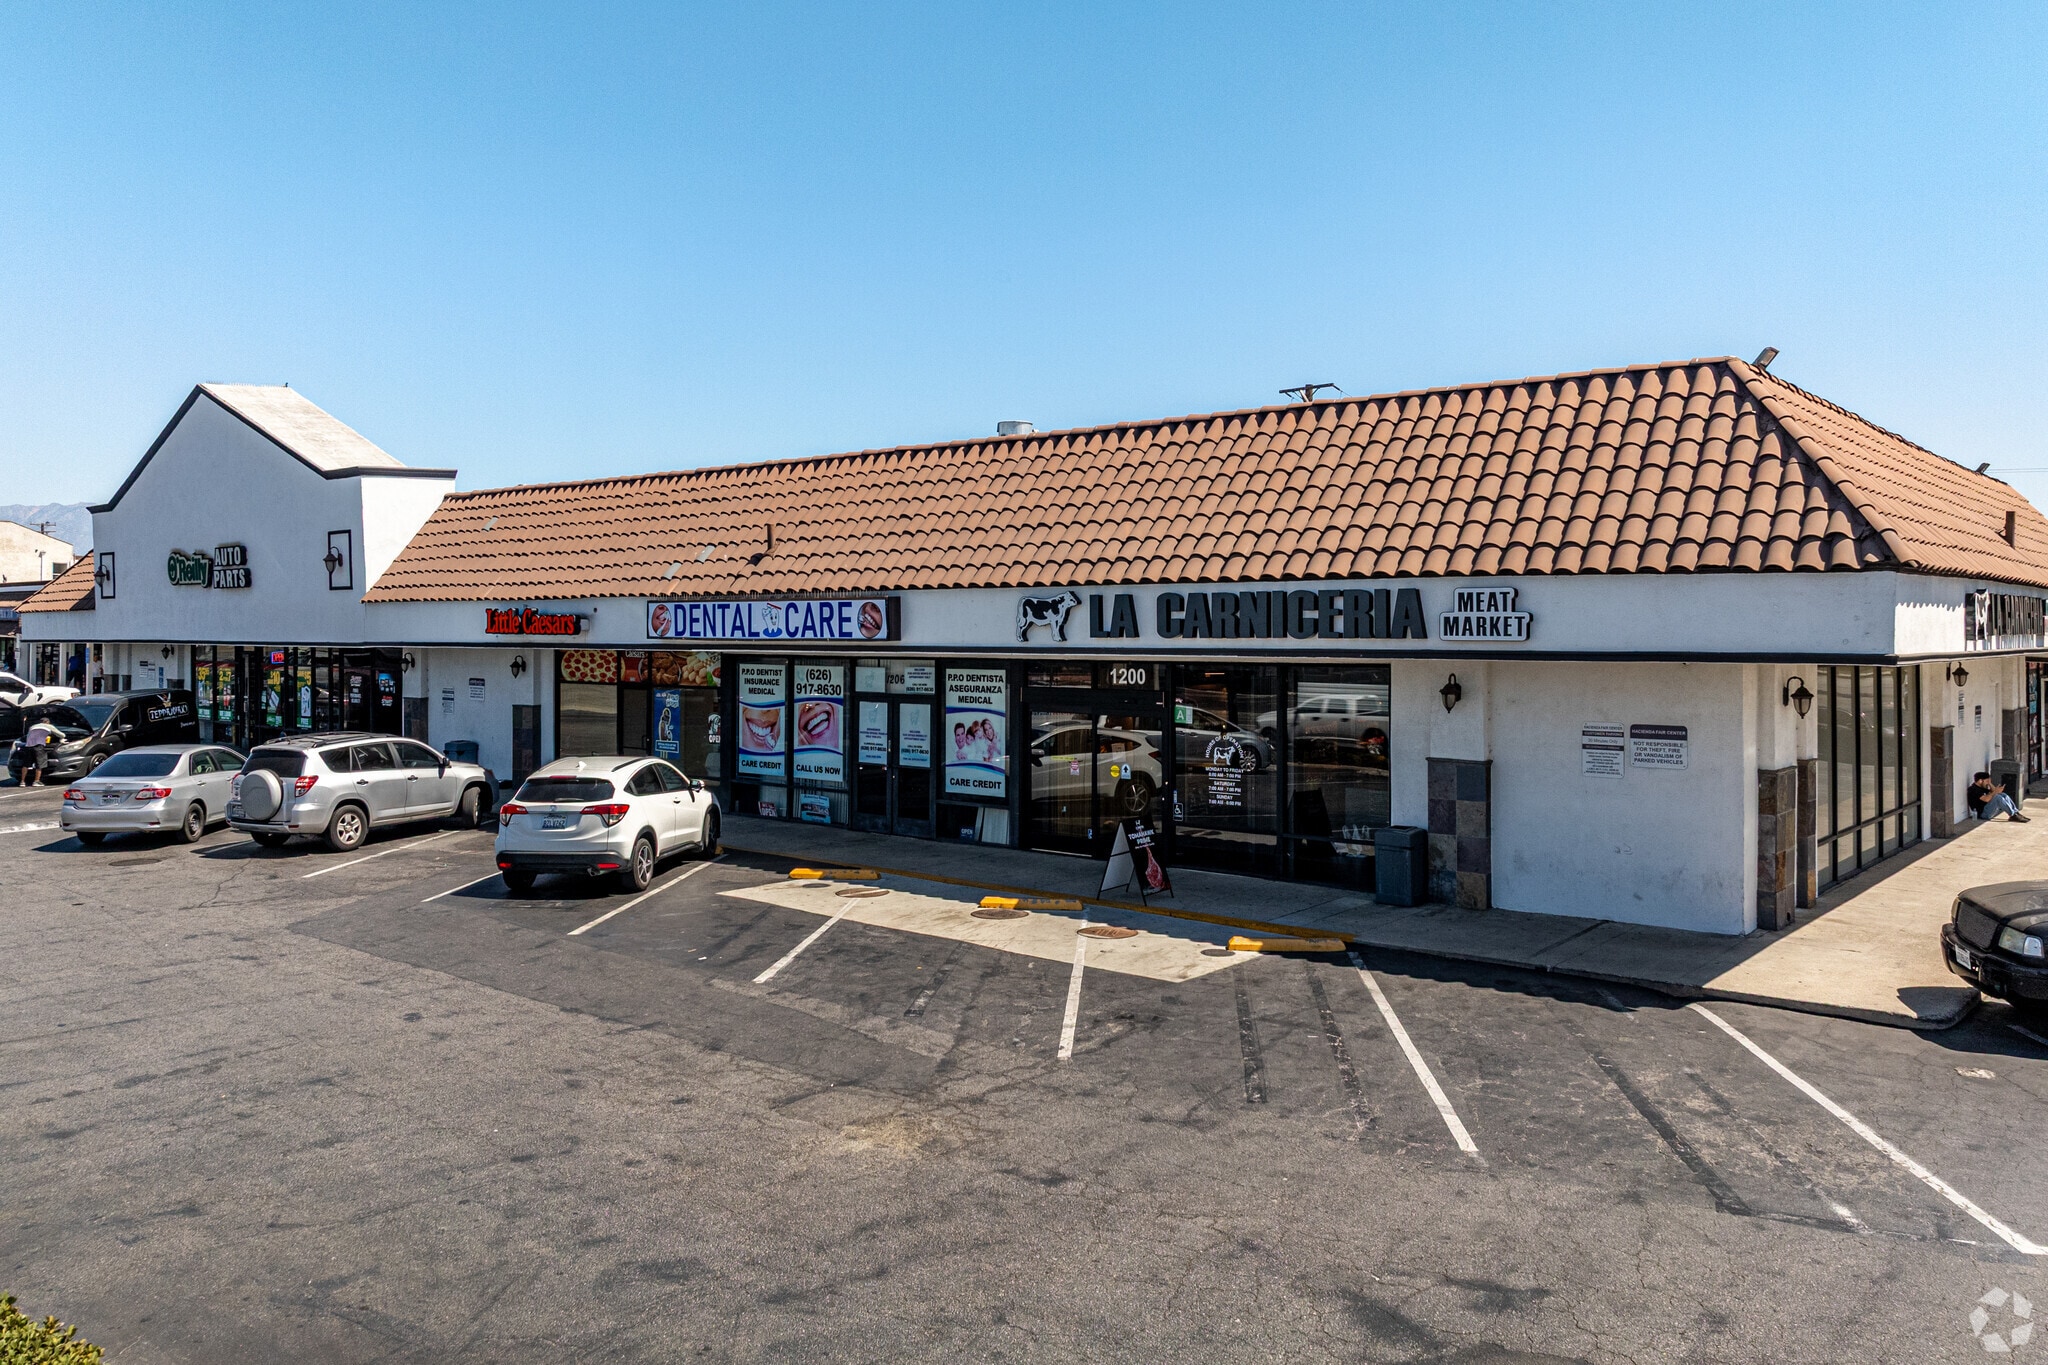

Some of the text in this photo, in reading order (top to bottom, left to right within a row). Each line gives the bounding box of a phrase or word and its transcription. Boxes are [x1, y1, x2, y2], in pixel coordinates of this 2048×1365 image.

[215, 547, 241, 566] AUTO
[168, 553, 210, 588] O'Reilly
[213, 569, 246, 588] PARTS
[1457, 592, 1511, 612] MEAT
[674, 601, 853, 638] DENTAL CARE
[1089, 587, 1428, 639] LA CARNICERIA
[485, 608, 575, 635] Little Caesars
[1443, 615, 1526, 637] MARKET
[756, 669, 783, 677] DENTIST
[806, 669, 832, 683] (626)
[948, 674, 1004, 683] P.P.O DENTISTA
[1110, 668, 1146, 685] 1200
[744, 678, 780, 686] INSURANCE
[748, 687, 776, 696] MEDICAL
[796, 683, 842, 696] 917-8630
[949, 685, 1003, 694] ASEGURANZA
[958, 696, 993, 704] MEDICAL
[1177, 710, 1185, 720] A
[1205, 739, 1216, 758] HOURS
[1222, 732, 1245, 759] OPERATION
[741, 760, 782, 770] CARE CREDIT
[796, 764, 841, 775] CALL US NOW
[950, 777, 1002, 790] CARE CREDIT
[1128, 829, 1155, 840] TOMAHAWK
